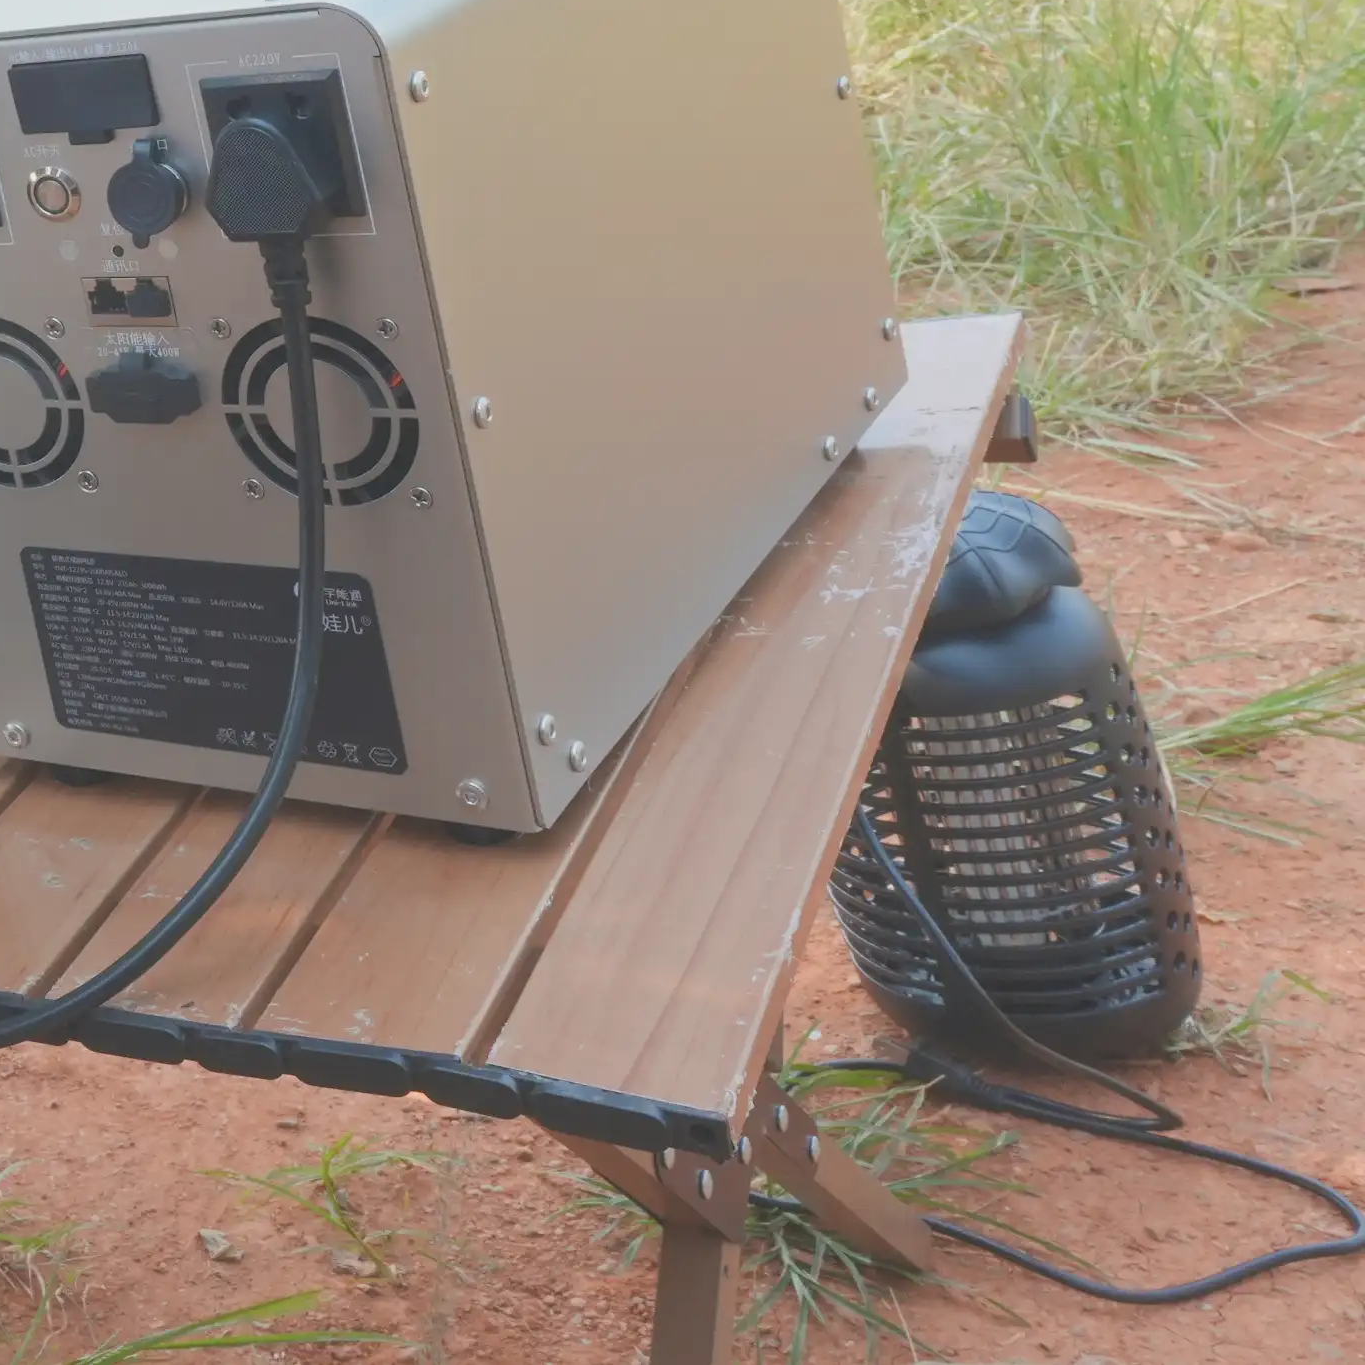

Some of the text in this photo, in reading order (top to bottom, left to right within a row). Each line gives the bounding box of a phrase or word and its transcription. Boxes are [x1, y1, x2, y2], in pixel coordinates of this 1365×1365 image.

[239, 53, 280, 67] AC220V
[101, 259, 141, 274] 通讯口
[103, 331, 171, 346] 太阳能输入
[155, 613, 170, 622] Max
